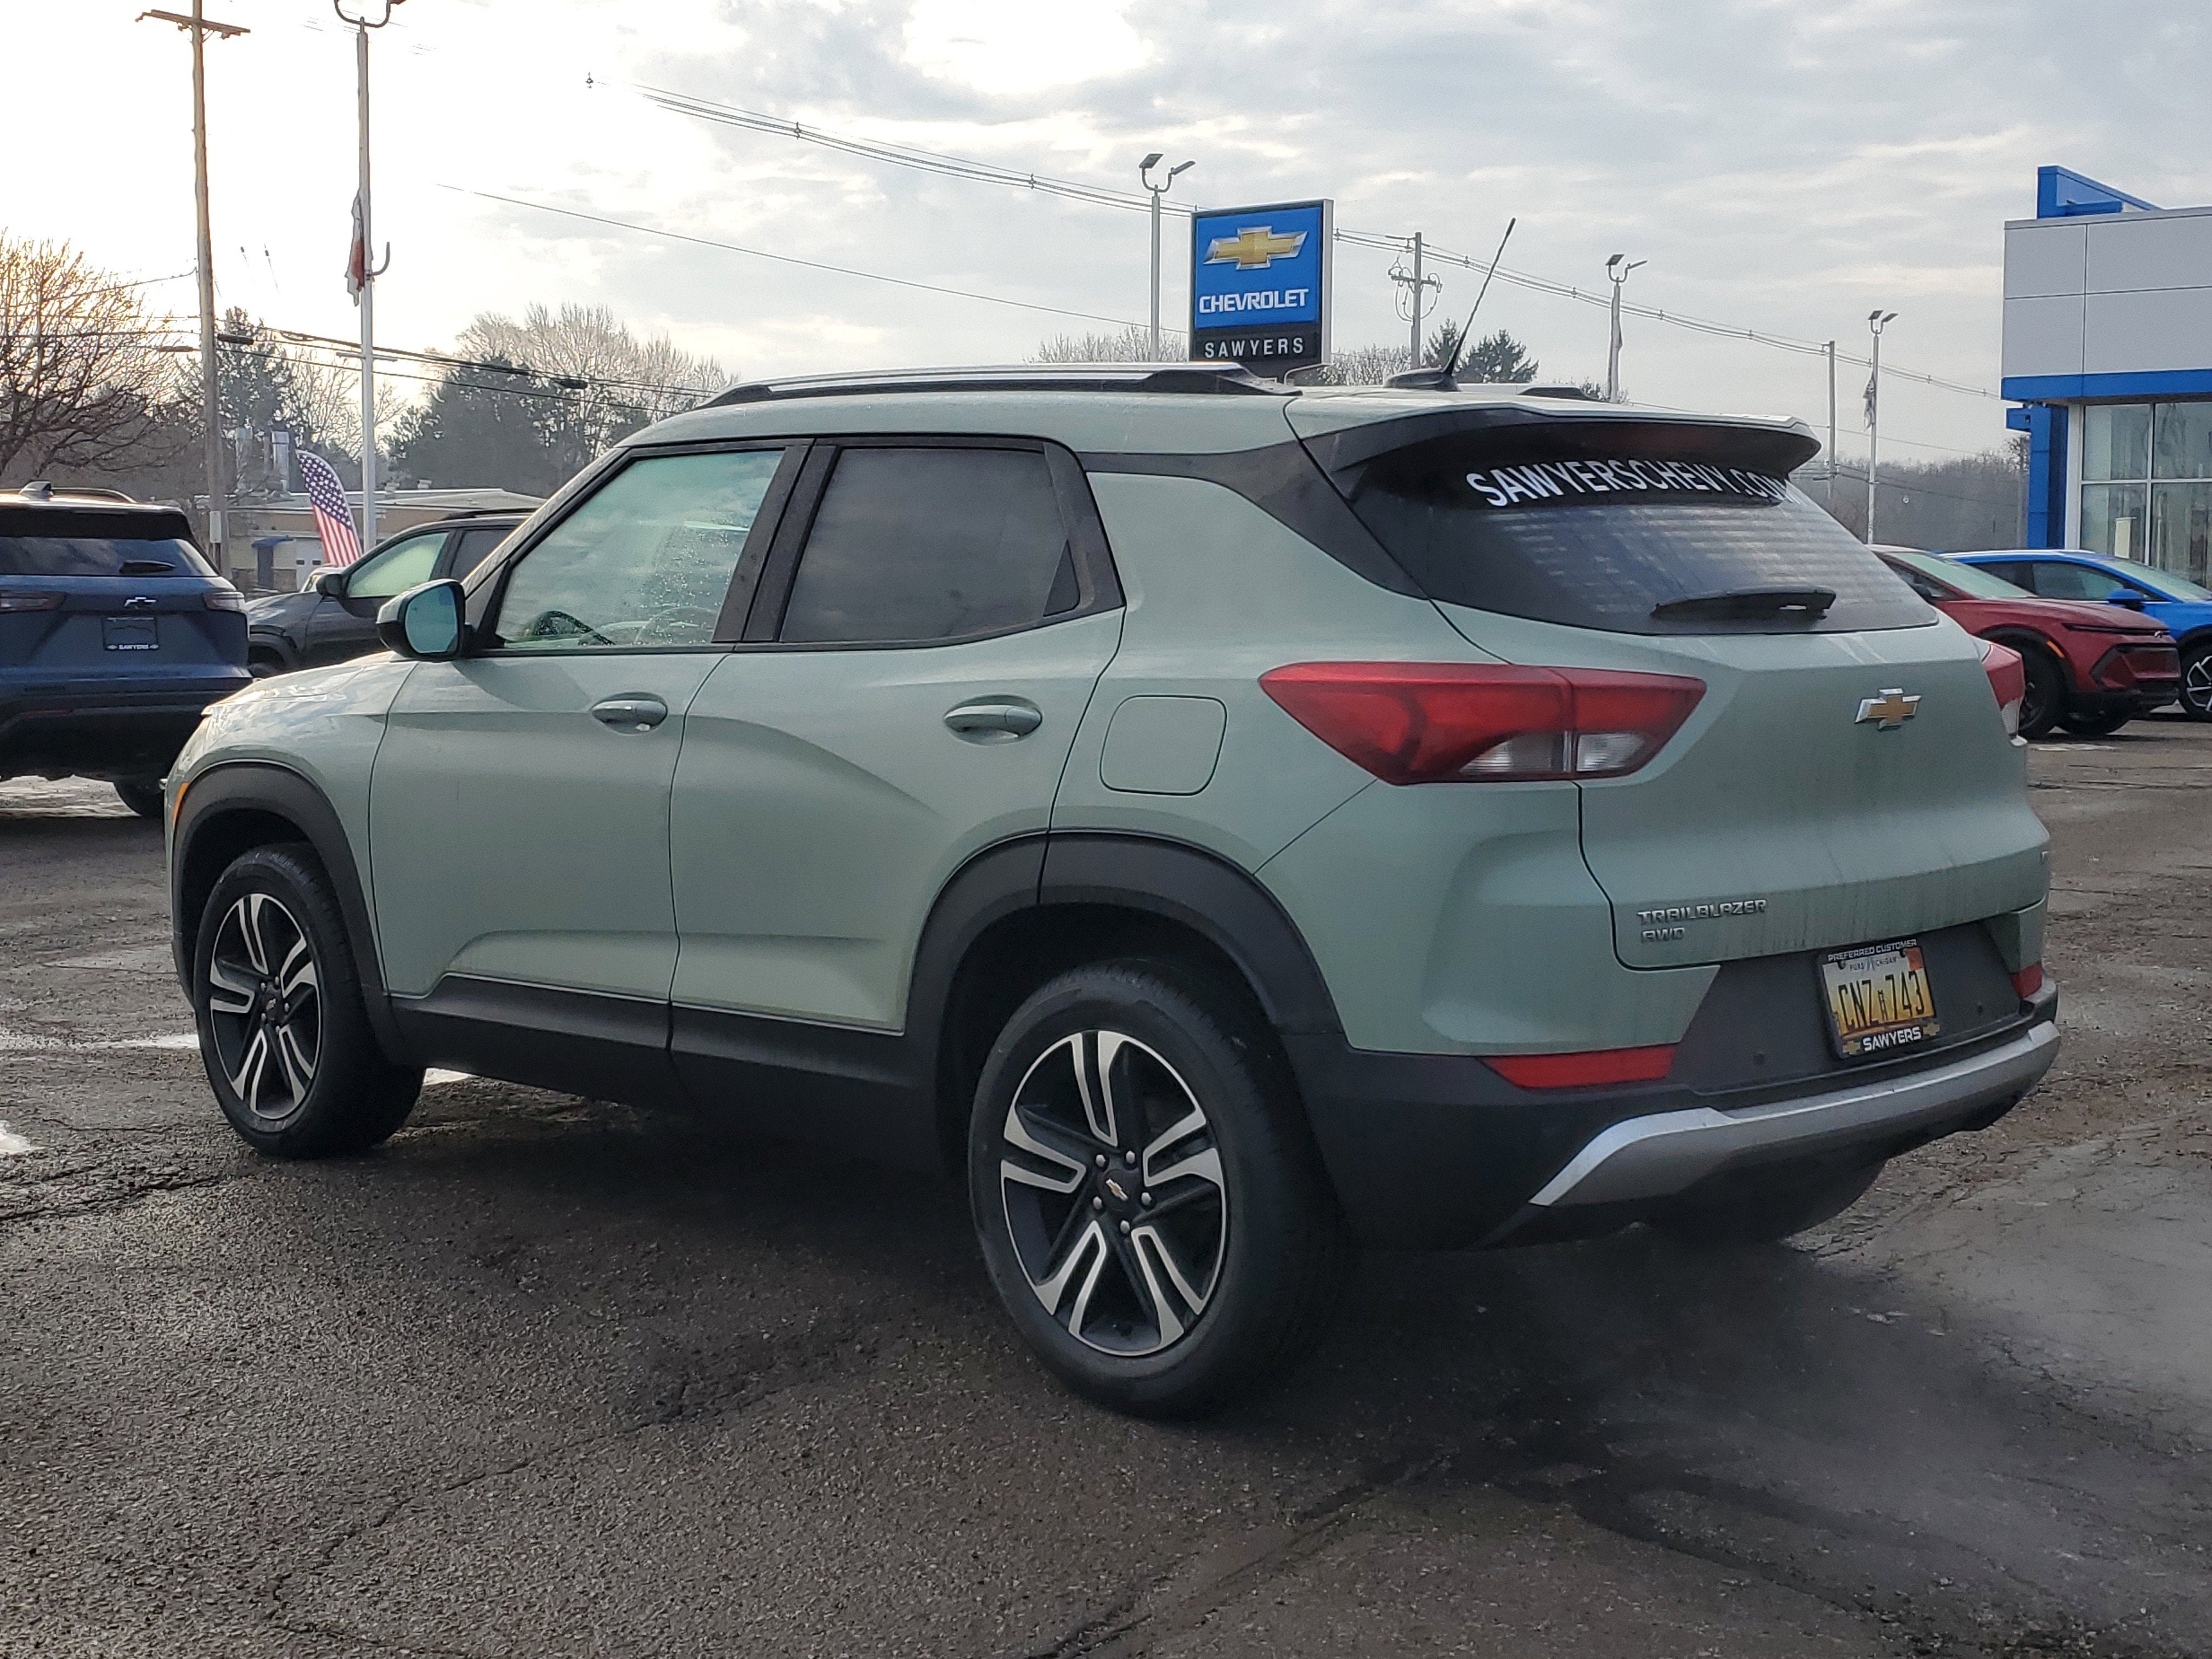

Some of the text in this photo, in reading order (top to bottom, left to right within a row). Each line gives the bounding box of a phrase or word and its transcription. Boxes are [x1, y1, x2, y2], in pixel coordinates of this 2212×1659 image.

[1199, 289, 1309, 313] CHEVROLET
[1205, 337, 1304, 358] SAWYERS
[1637, 899, 1767, 925] TRAILBLAZER
[1641, 927, 1685, 944] AWD
[1827, 939, 1917, 962] PREFERRED CUSTOMER
[1863, 1026, 1922, 1052] SAWYERS
